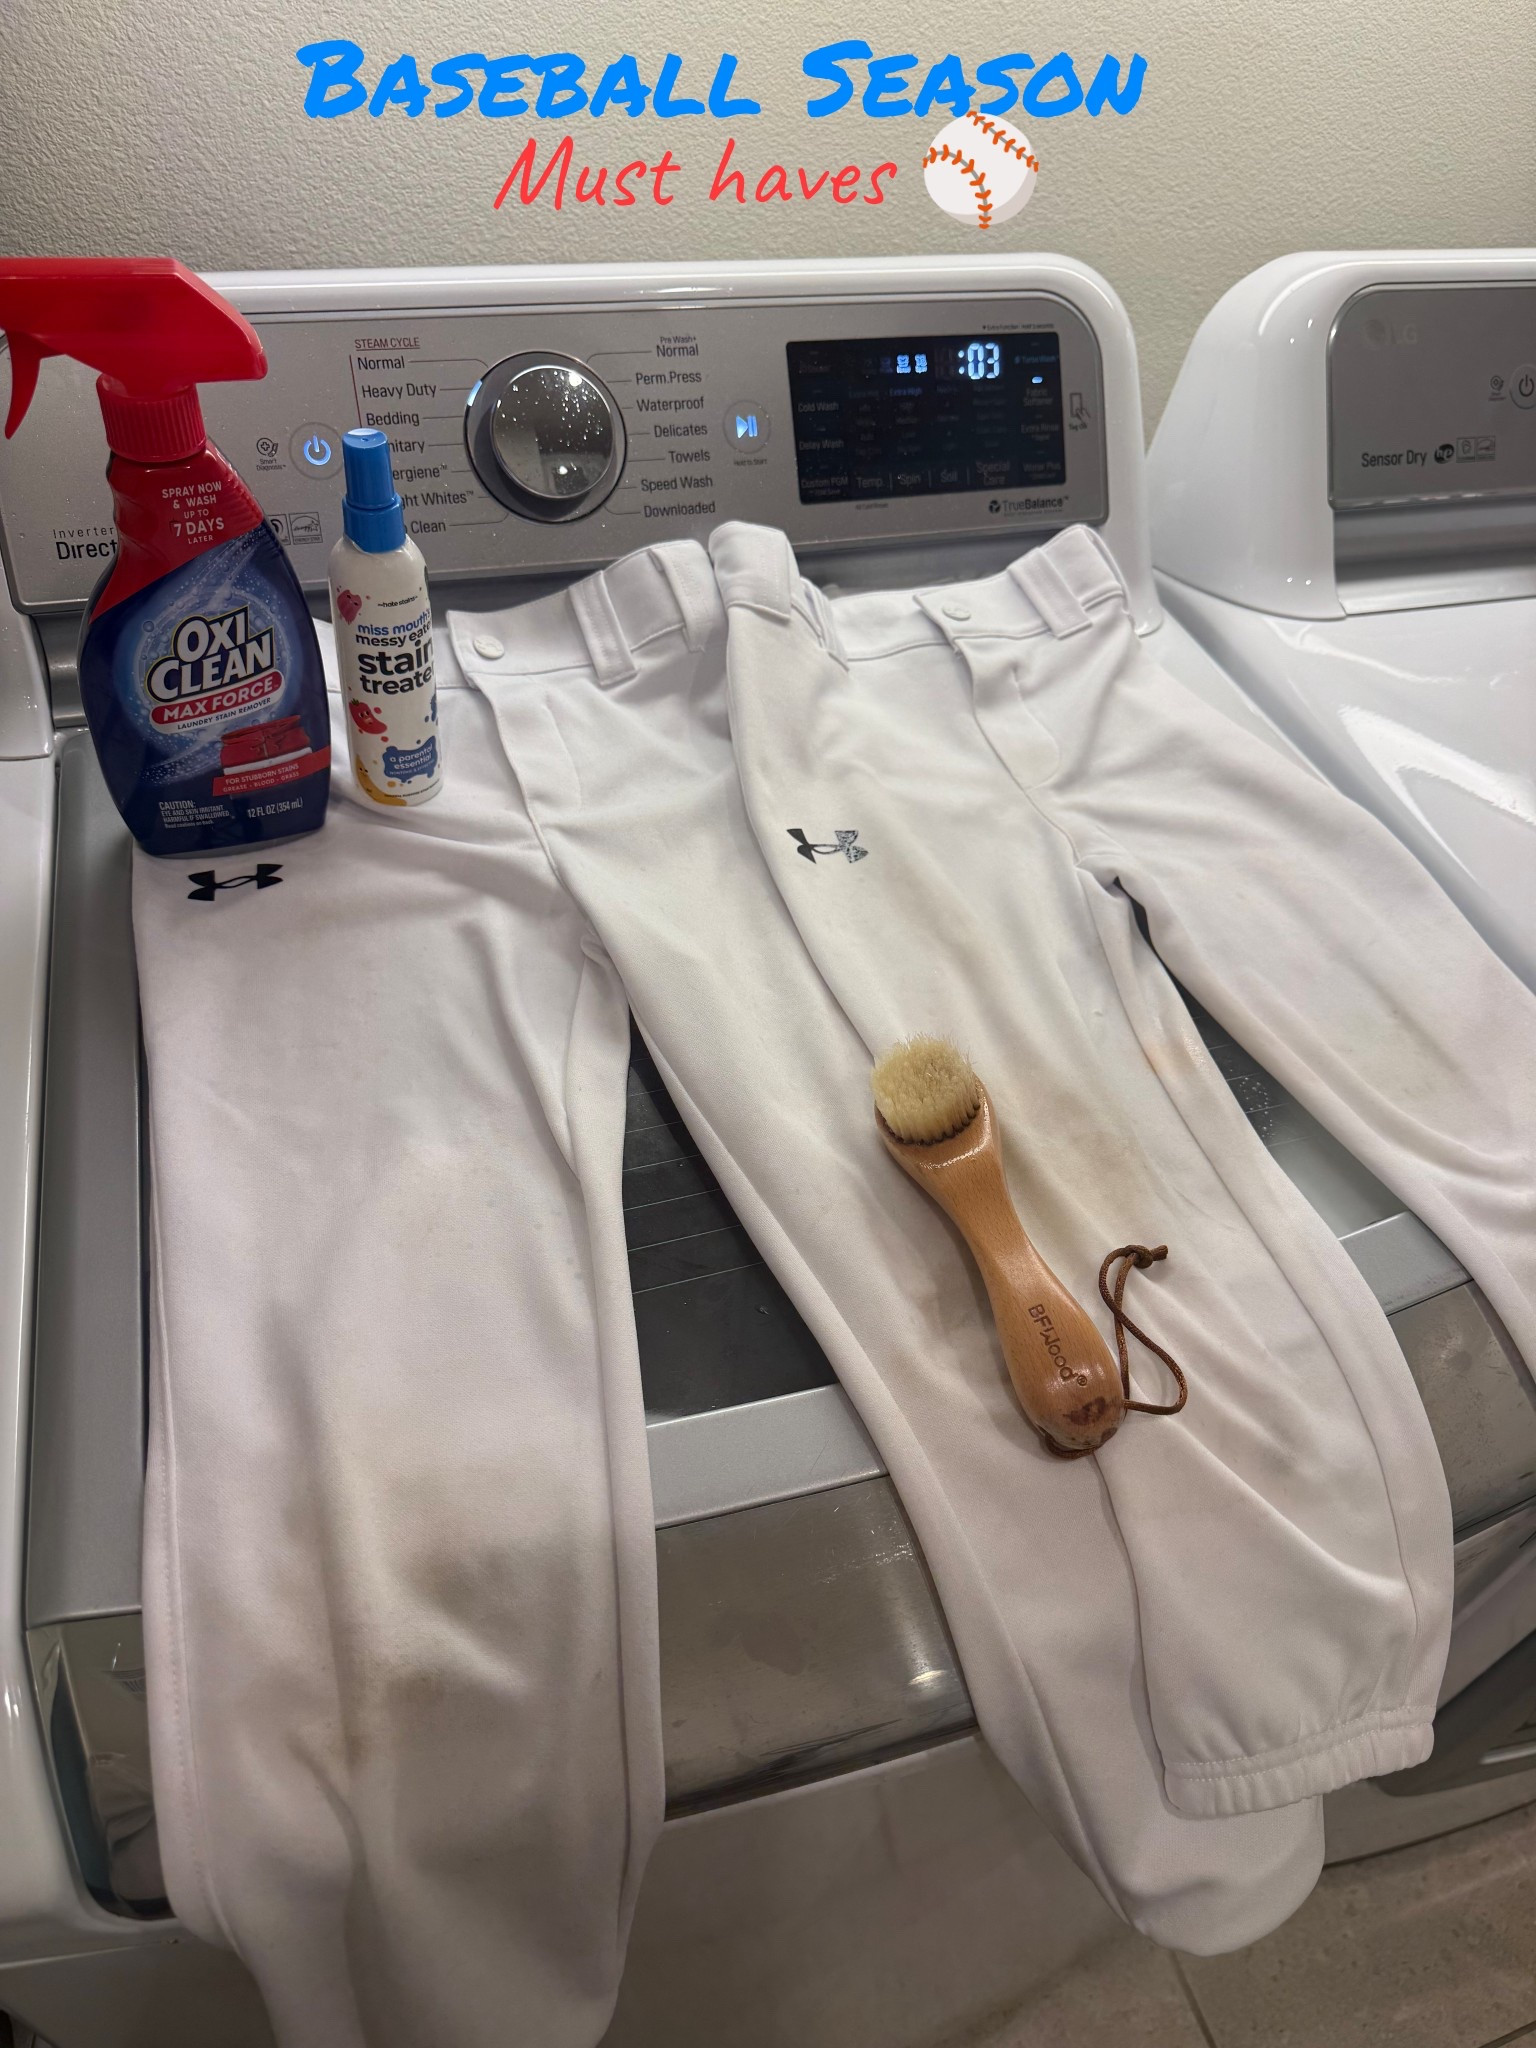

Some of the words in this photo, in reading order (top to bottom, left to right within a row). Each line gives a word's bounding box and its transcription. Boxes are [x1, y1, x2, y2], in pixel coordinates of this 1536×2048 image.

[355, 339, 389, 349] STEAM
[391, 337, 420, 347] CYCLE
[660, 336, 672, 344] Pre
[657, 343, 699, 357] Normal
[357, 355, 405, 370] Normal
[362, 385, 403, 399] Heavy
[406, 383, 437, 398] Duty
[636, 397, 704, 413] Waterproof
[366, 411, 421, 427] Bedding
[654, 424, 708, 438] Delicates
[388, 439, 425, 454] nitary
[668, 449, 711, 463] Towels
[1361, 453, 1403, 467] Sensor
[1406, 449, 1427, 467] Dry
[162, 485, 195, 499] SPRAY
[197, 480, 222, 494] NOW
[641, 478, 678, 494] Speed
[680, 475, 714, 489] Wash
[173, 499, 181, 509] &
[186, 494, 217, 508] WASH
[183, 510, 195, 519] UP
[197, 508, 210, 517] TO
[643, 501, 716, 518] Downloaded
[53, 527, 114, 539] Inverter
[173, 523, 182, 537] 7
[185, 517, 225, 535] DAYS
[410, 520, 447, 534] Clean
[187, 534, 214, 545] LATER
[176, 611, 246, 662] OXI
[357, 624, 389, 636] miss
[355, 634, 407, 648] messy
[150, 633, 271, 700] CLEAN
[163, 699, 209, 721] MAX
[212, 676, 274, 711] FORCE
[177, 717, 213, 730] LAUNDRY
[215, 711, 237, 721] STAIN
[238, 697, 271, 714] REMOVER
[398, 743, 433, 763] parental
[393, 753, 432, 770] essential
[225, 777, 240, 786] FOR
[241, 768, 277, 783] STUBBORN
[277, 763, 300, 774] STAINS
[254, 778, 275, 787] BLOOD
[159, 799, 197, 811] CAUTION:
[247, 808, 257, 819] 12
[257, 806, 266, 817] FL
[266, 804, 276, 815] OZ
[276, 800, 291, 814] (354
[291, 796, 304, 810] mL)
